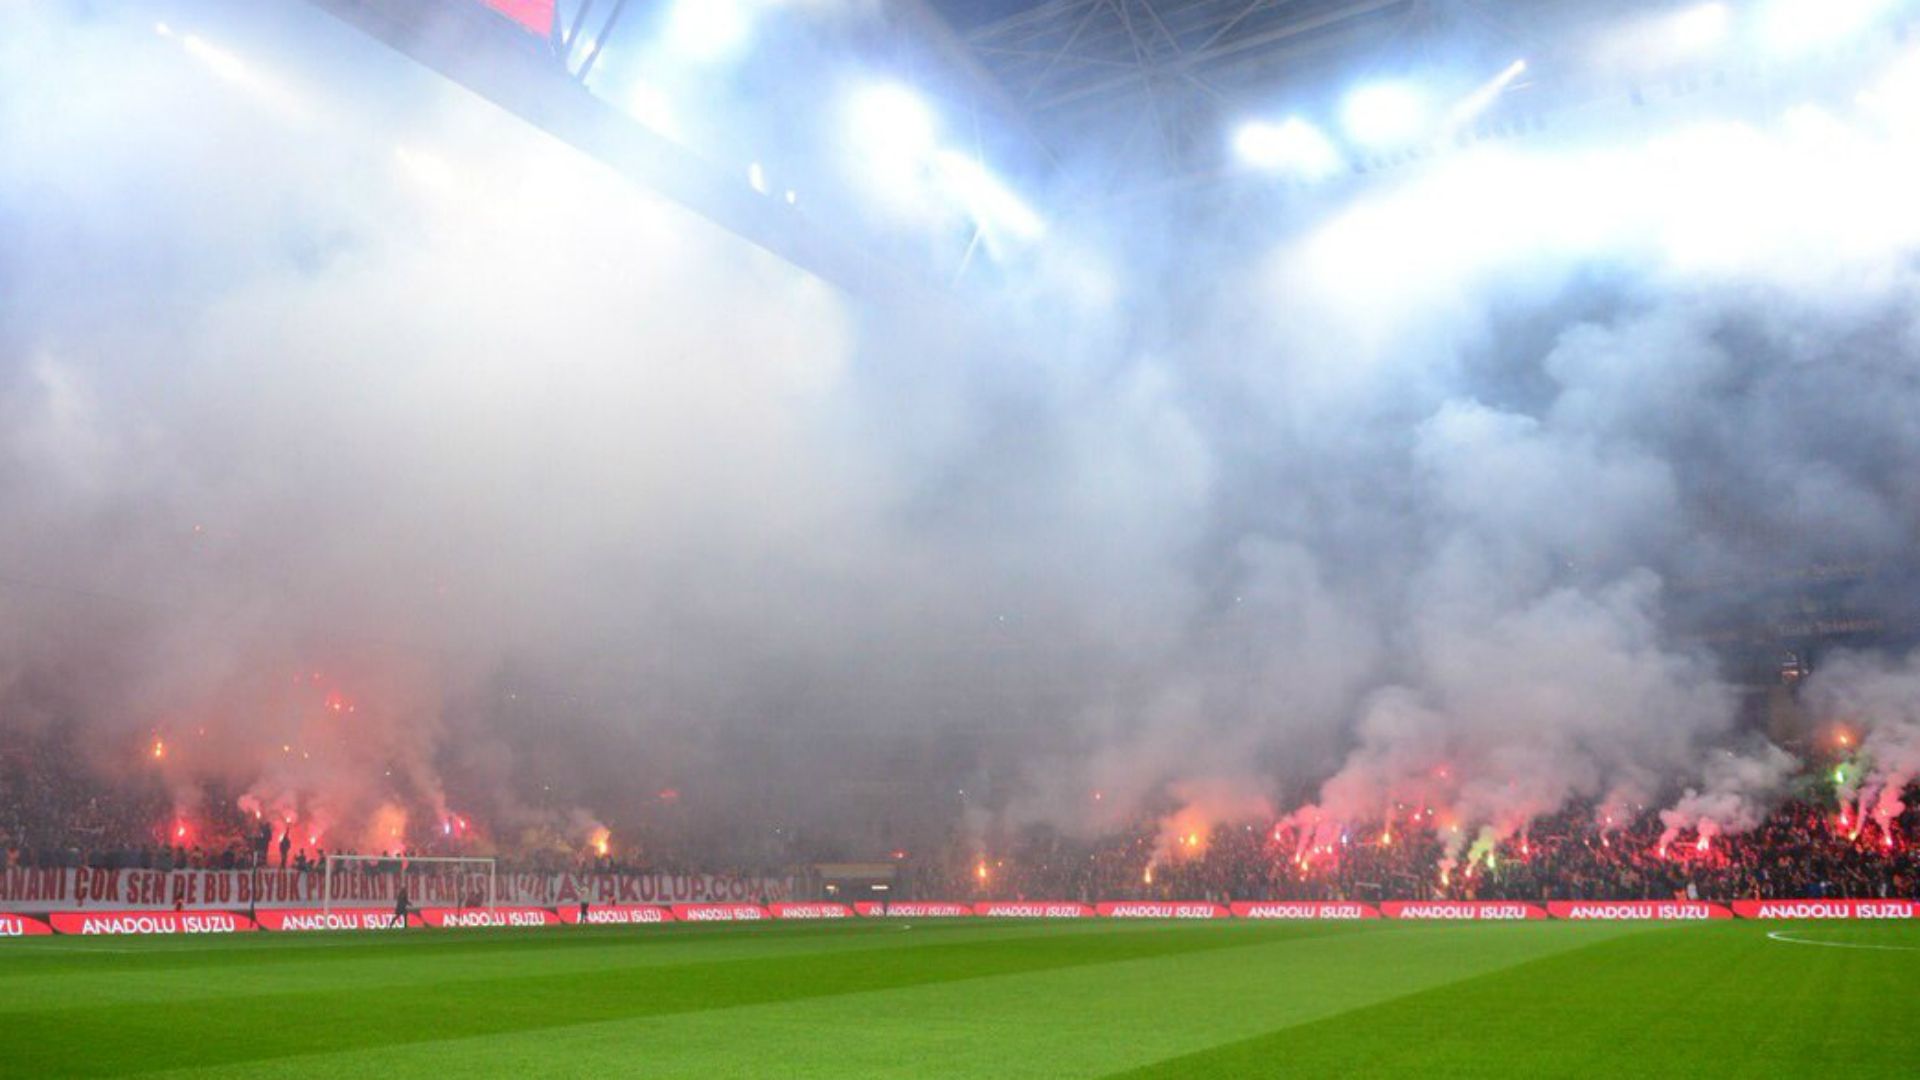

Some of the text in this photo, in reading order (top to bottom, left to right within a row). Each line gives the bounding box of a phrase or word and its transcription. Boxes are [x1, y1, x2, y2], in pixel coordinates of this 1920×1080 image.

[75, 866, 119, 907] ÇOK
[127, 871, 165, 904] SEN
[173, 872, 197, 904] DE
[205, 871, 231, 904] BU
[509, 911, 545, 926] ISUZU
[631, 910, 661, 923] ISUZU
[987, 905, 1080, 917] ANADOLU ISUZU
[1111, 906, 1214, 918] ANADOLU ISUZU
[1247, 906, 1361, 919] ANADOLU ISUZU
[1400, 906, 1526, 919] ANADOLU ISUZU
[1569, 904, 1709, 919] ANADOLU ISUZU
[1757, 904, 1912, 919] ANADOLU ISUZU
[82, 916, 235, 934] ANADOLU ISUZU
[282, 914, 358, 931] ANADOLU
